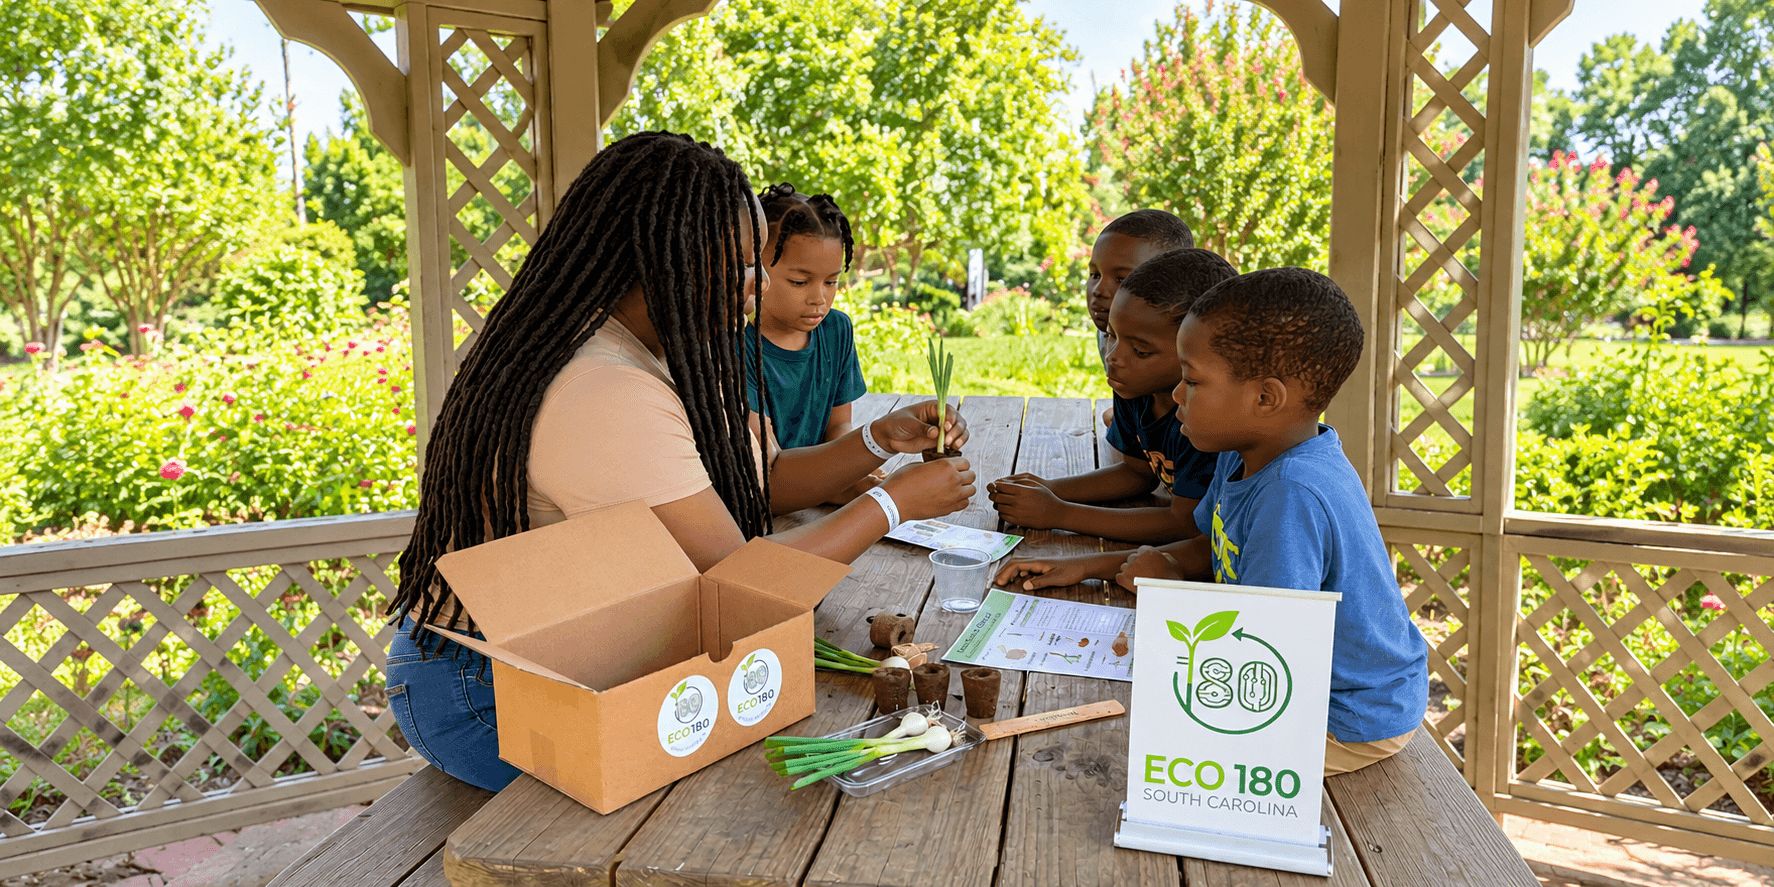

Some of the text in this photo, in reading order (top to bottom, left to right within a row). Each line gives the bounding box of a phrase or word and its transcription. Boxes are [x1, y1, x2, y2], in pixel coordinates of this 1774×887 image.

[1144, 754, 1301, 799] ECO 180
[1142, 787, 1299, 819] SOUTH CAROLINA
